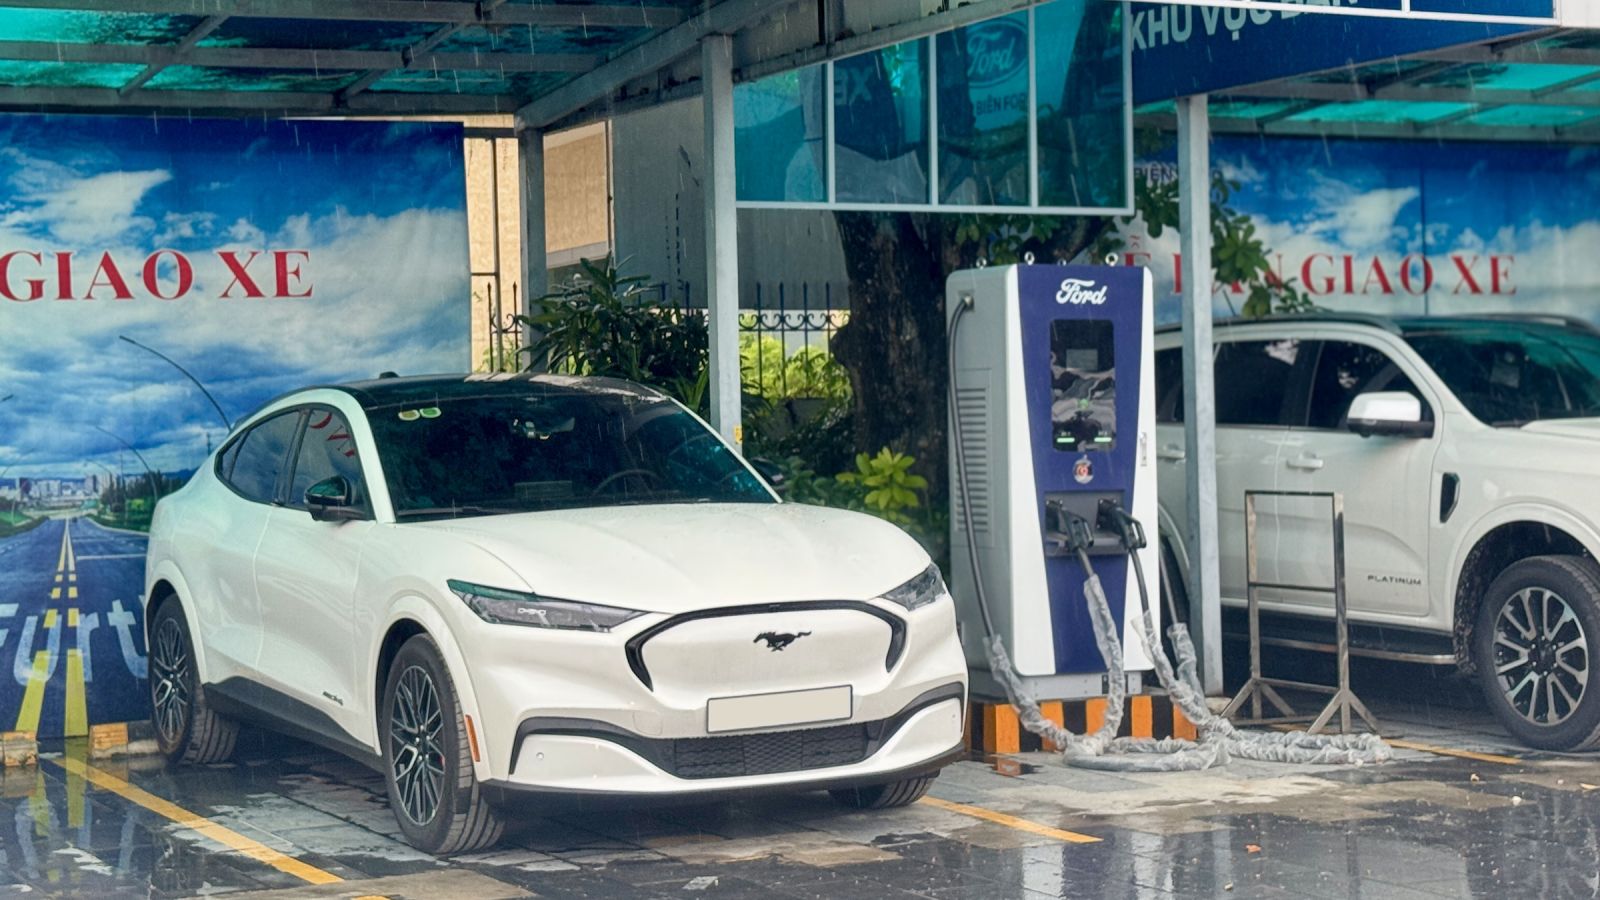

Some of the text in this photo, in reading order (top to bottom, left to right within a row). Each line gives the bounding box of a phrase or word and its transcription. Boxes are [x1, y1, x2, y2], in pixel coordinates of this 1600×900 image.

[1131, 6, 1193, 50] KHU
[967, 30, 1016, 78] Ford
[0, 250, 314, 302] GIAO XE
[1056, 278, 1108, 304] Ford
[1301, 253, 1433, 296] GIAO
[1452, 255, 1517, 295] XE
[1367, 575, 1421, 585] PLATINUM
